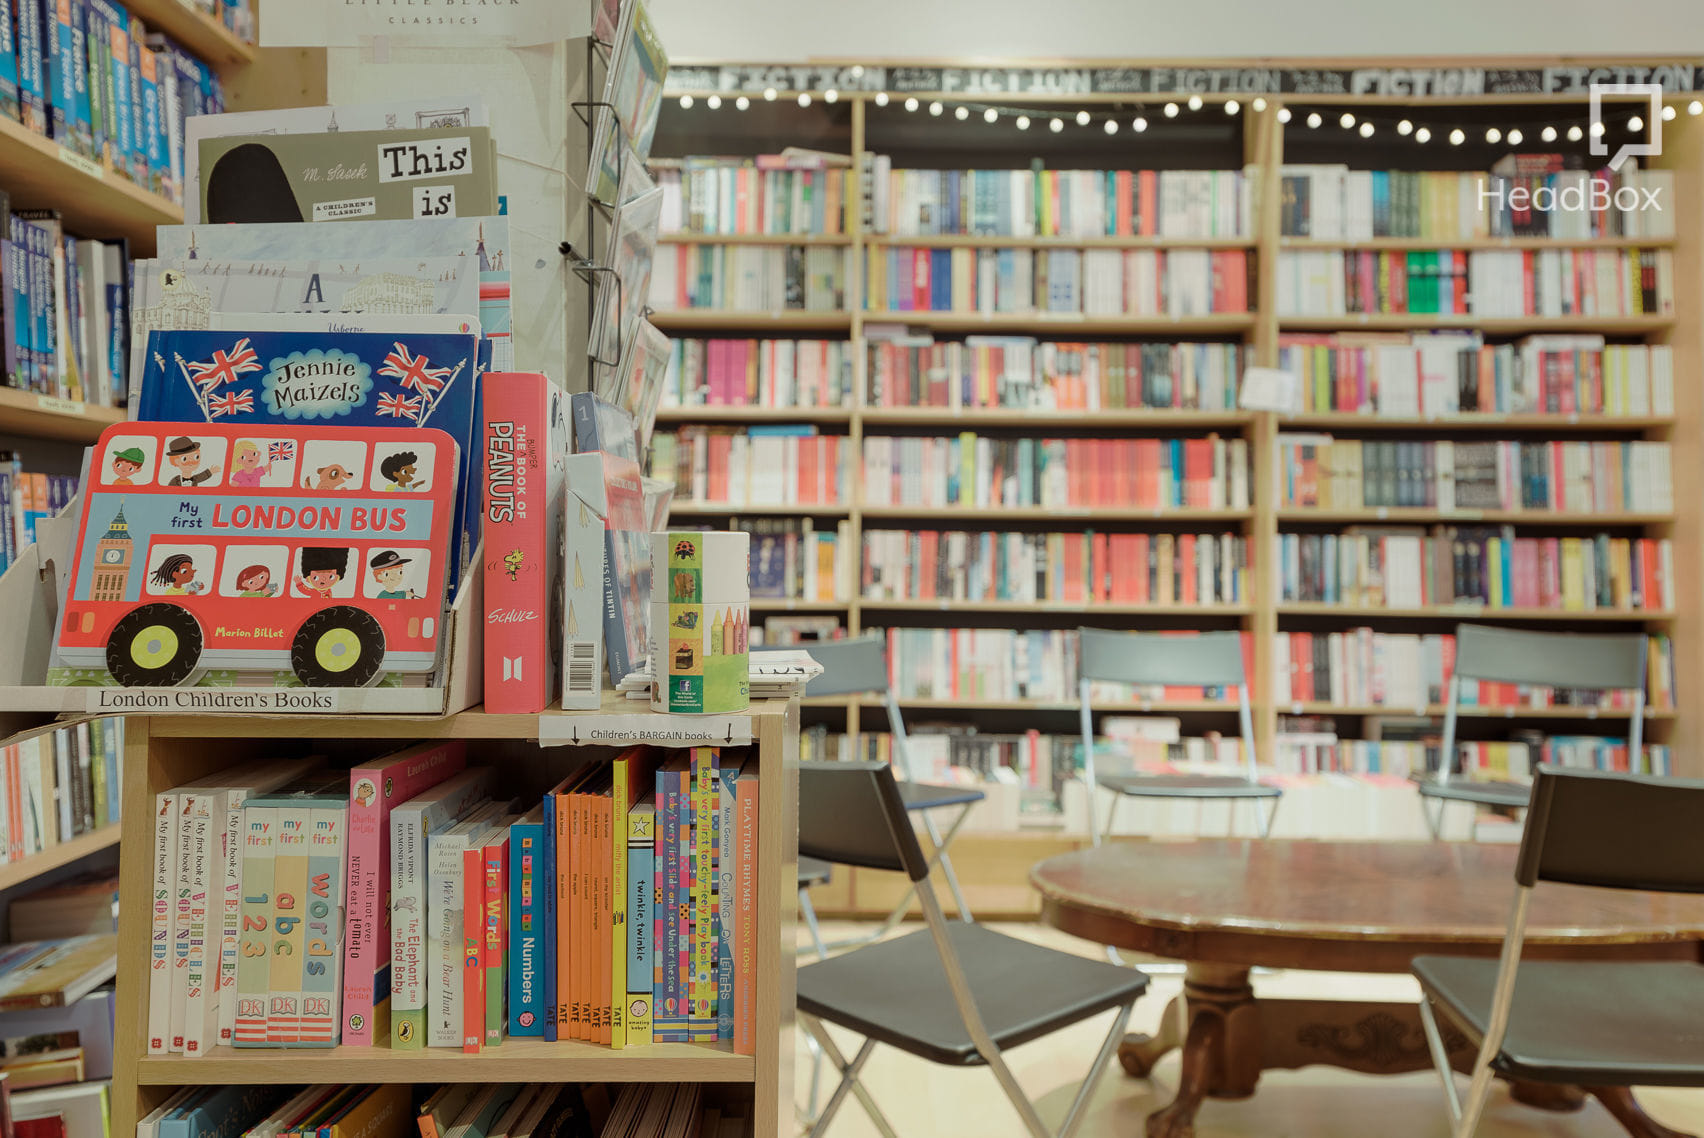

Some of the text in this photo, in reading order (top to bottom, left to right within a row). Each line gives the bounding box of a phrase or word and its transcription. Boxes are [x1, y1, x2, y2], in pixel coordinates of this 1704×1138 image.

[72, 28, 85, 93] France
[718, 66, 886, 91] FICTION
[942, 69, 1091, 95] FICTION
[1151, 69, 1281, 94] FICTION
[1351, 69, 1485, 97] FICTION
[1543, 64, 1696, 94] FICTION
[383, 145, 468, 178] This
[323, 201, 374, 211] CHILDREN'S
[328, 208, 362, 217] CLASSIC
[421, 189, 452, 216] is
[301, 273, 326, 304] A
[277, 360, 356, 383] Jennie
[273, 381, 361, 410] Maizels
[578, 405, 589, 421] 1
[527, 439, 538, 469] BUMPER
[488, 421, 515, 524] PEANUTS
[516, 425, 526, 519] THE BOOK OF
[179, 501, 199, 518] My
[212, 504, 408, 532] LONDON BUS
[171, 516, 203, 529] first
[605, 577, 611, 587] OF
[606, 590, 616, 619] TINTIN
[215, 626, 284, 639] Marion Billet
[99, 690, 333, 709] London Children's Books
[591, 730, 712, 741] Children's BARGAIN books
[251, 821, 269, 833] my
[284, 819, 302, 831] my
[317, 820, 335, 832] my
[743, 798, 752, 861] PLAYTIME
[247, 835, 273, 846] first
[280, 832, 305, 844] first
[313, 833, 338, 845] first
[722, 825, 730, 858] Gonyea
[614, 844, 622, 861] miffy
[351, 856, 360, 887] NEVER
[698, 766, 710, 966] Baby's very first touchy-feely Play book
[152, 820, 169, 970] My first book of SOUNDS
[175, 820, 192, 969] My first book of SOUNDS
[351, 890, 359, 905] eat
[365, 879, 374, 897] will
[443, 880, 453, 905] We're
[667, 792, 677, 992] Baby's very first Slide and see Under the sea
[742, 864, 751, 911] RHYMES
[188, 822, 206, 998] My first book of VEHICLES
[221, 815, 239, 988] My first book of VEHICLES
[365, 902, 373, 918] not
[486, 860, 501, 950] First Words
[274, 893, 301, 956] abc
[307, 873, 333, 976] words
[364, 922, 372, 944] ever
[409, 918, 418, 933] The
[441, 908, 453, 937] Going
[636, 880, 645, 961] twinkle, twinkle
[350, 918, 362, 959] tomato
[443, 940, 452, 952] on
[395, 942, 405, 962] Bad
[406, 936, 420, 987] Elephant
[465, 938, 478, 967] ABC
[392, 966, 405, 994] Baby
[442, 963, 452, 986] Bear
[521, 937, 535, 1003] Numbers
[240, 1000, 263, 1016] DK
[272, 998, 296, 1013] DK
[305, 999, 329, 1014] DK
[442, 989, 453, 1016] Hunt
[559, 1004, 567, 1024] TATE
[571, 1002, 579, 1023] TATE
[582, 1003, 590, 1023] TATE
[546, 1006, 554, 1026] TATE
[592, 1007, 600, 1028] TATE
[602, 1006, 610, 1026] TATE
[613, 1006, 622, 1027] TATE
